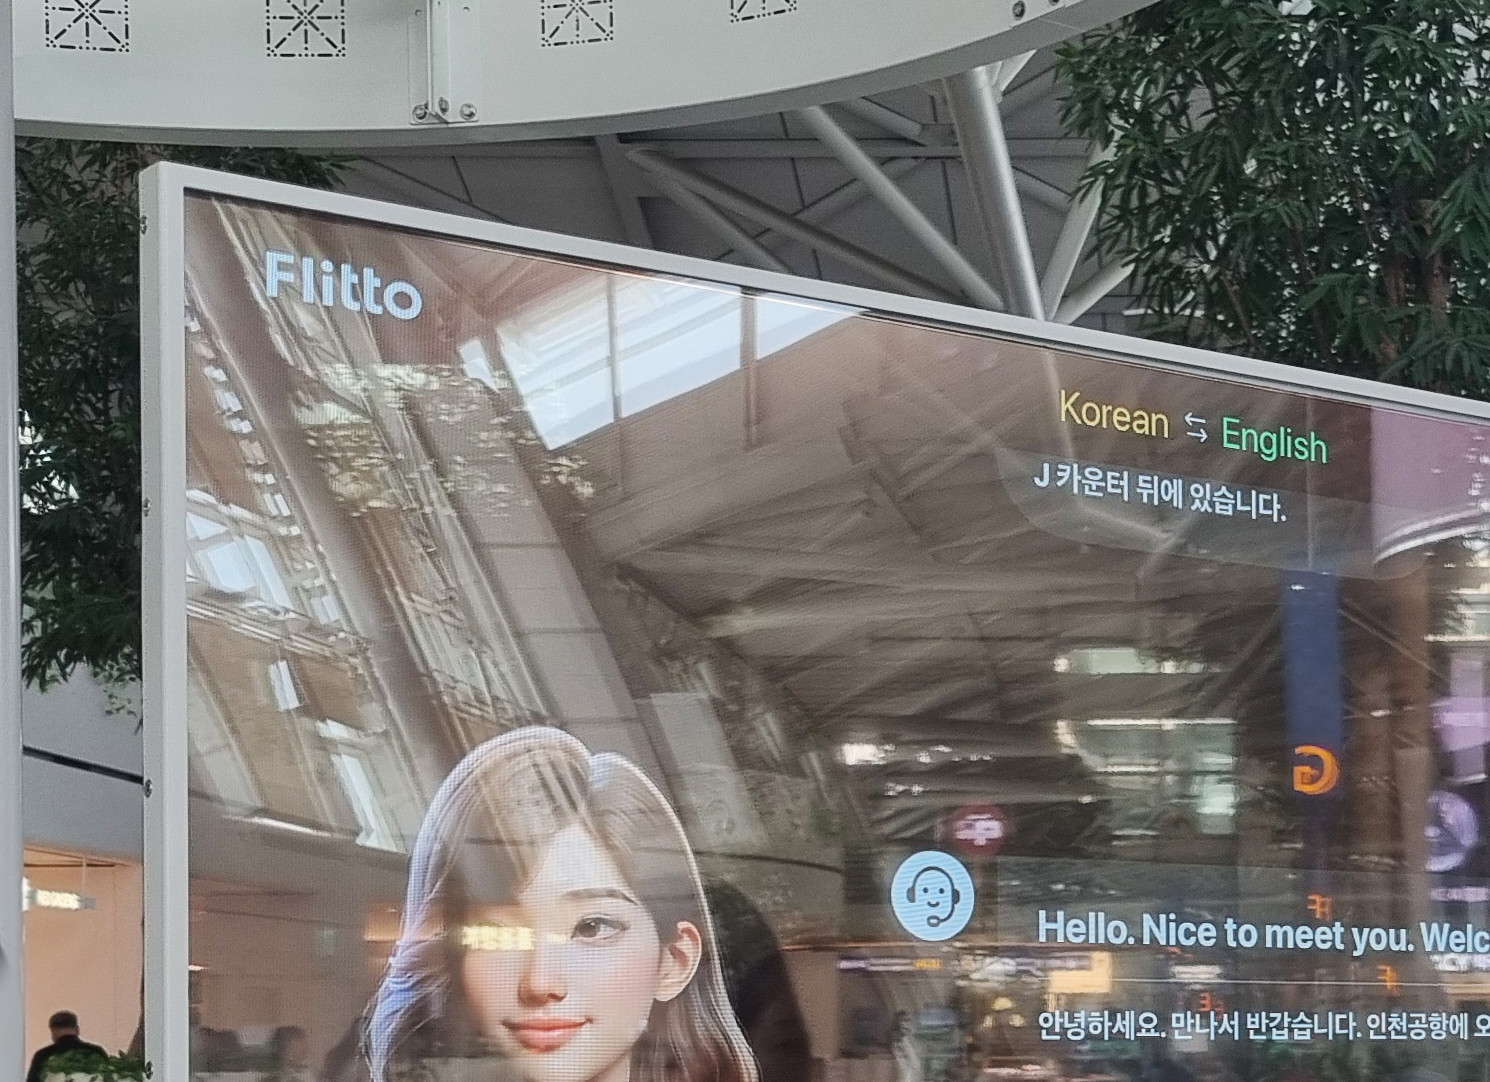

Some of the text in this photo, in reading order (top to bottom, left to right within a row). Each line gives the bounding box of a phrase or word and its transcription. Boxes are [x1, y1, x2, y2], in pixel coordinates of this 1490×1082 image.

[265, 249, 423, 321] Flitto
[1059, 389, 1328, 464] Korean English
[1033, 462, 1287, 523] J 카운터 뒤에 있습니다.
[1038, 909, 1136, 945] Hello.
[1142, 912, 1217, 948] Nice
[1224, 916, 1258, 949] to
[1265, 921, 1345, 950] meet
[1351, 927, 1415, 957] you.
[1038, 1010, 1166, 1042] 안녕하세요.
[1171, 1010, 1239, 1041] 만나서
[1246, 1011, 1362, 1041] 반갑습니다.
[1366, 1012, 1468, 1041] 인천공항에
